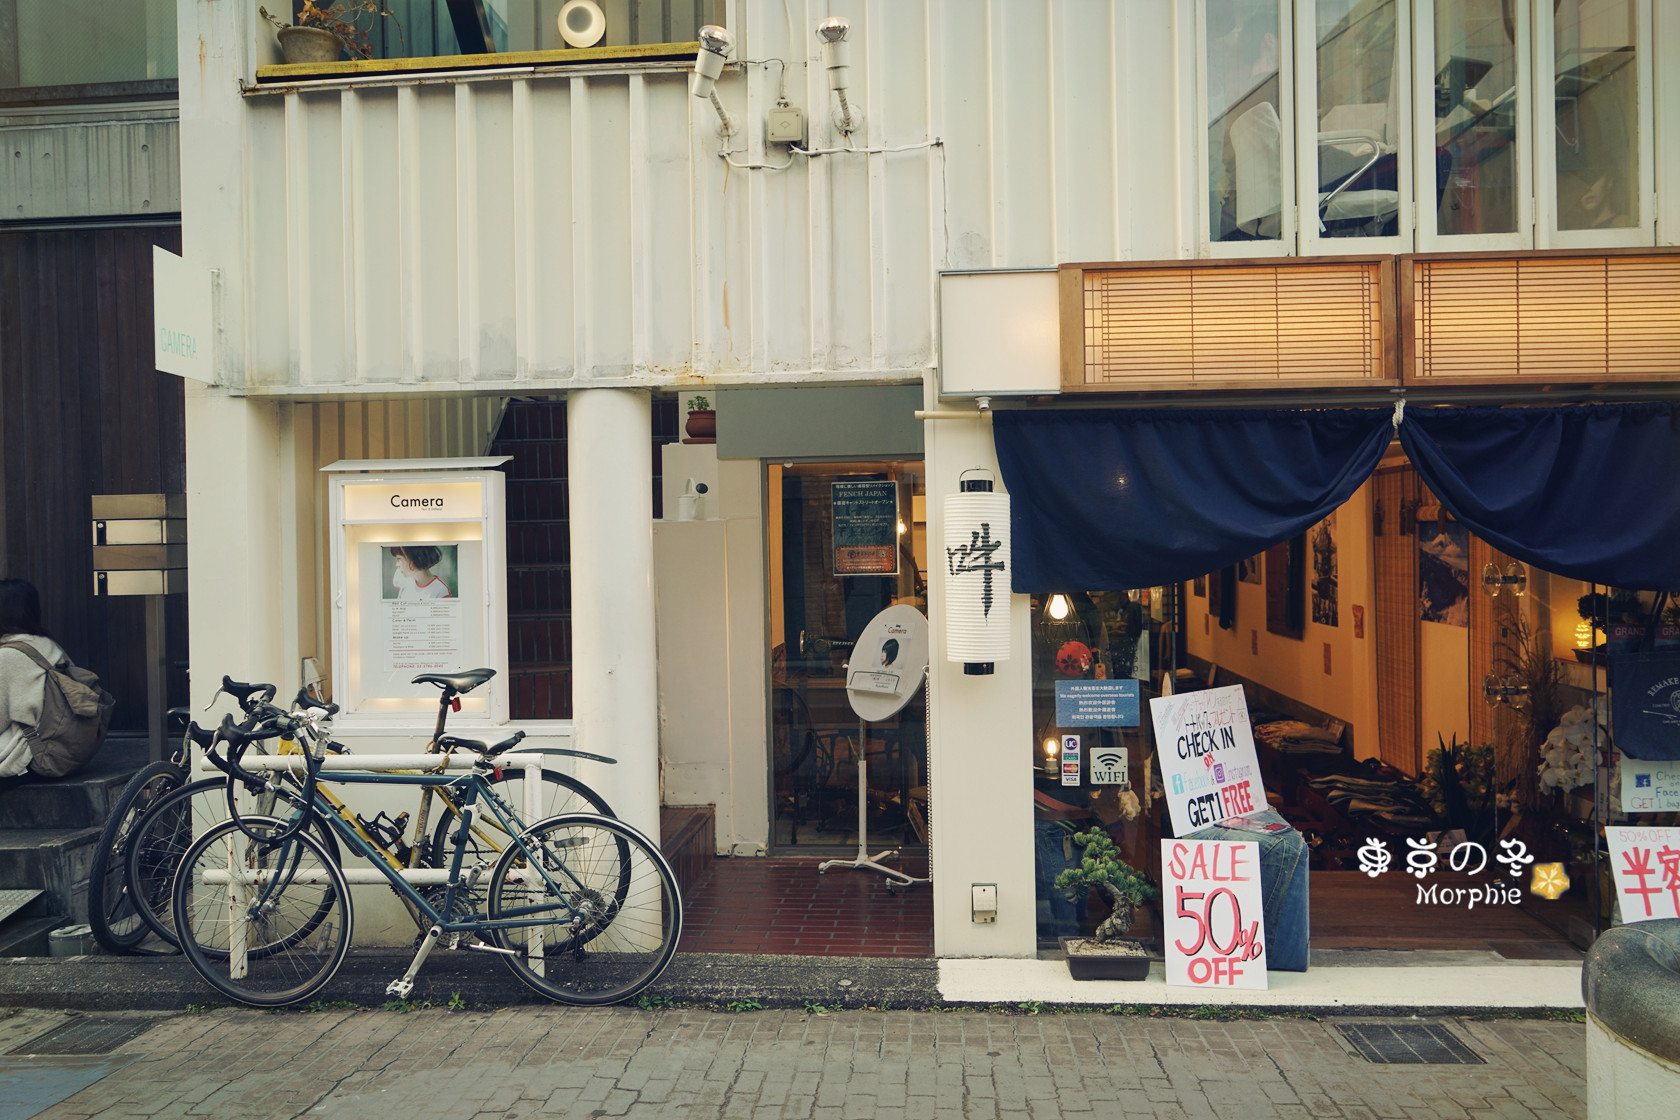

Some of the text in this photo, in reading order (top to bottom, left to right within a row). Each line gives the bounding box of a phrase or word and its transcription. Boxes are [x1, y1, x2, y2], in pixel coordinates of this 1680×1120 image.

[160, 327, 198, 360] CAMERA
[390, 494, 444, 508] Camera
[887, 626, 908, 635] Camera
[1177, 725, 1236, 760] CHECK IN
[1221, 780, 1254, 818] FREE
[1630, 796, 1654, 809] GET
[1168, 842, 1252, 882] SALE
[1174, 885, 1263, 962] 50%
[1187, 957, 1244, 986] OFF
